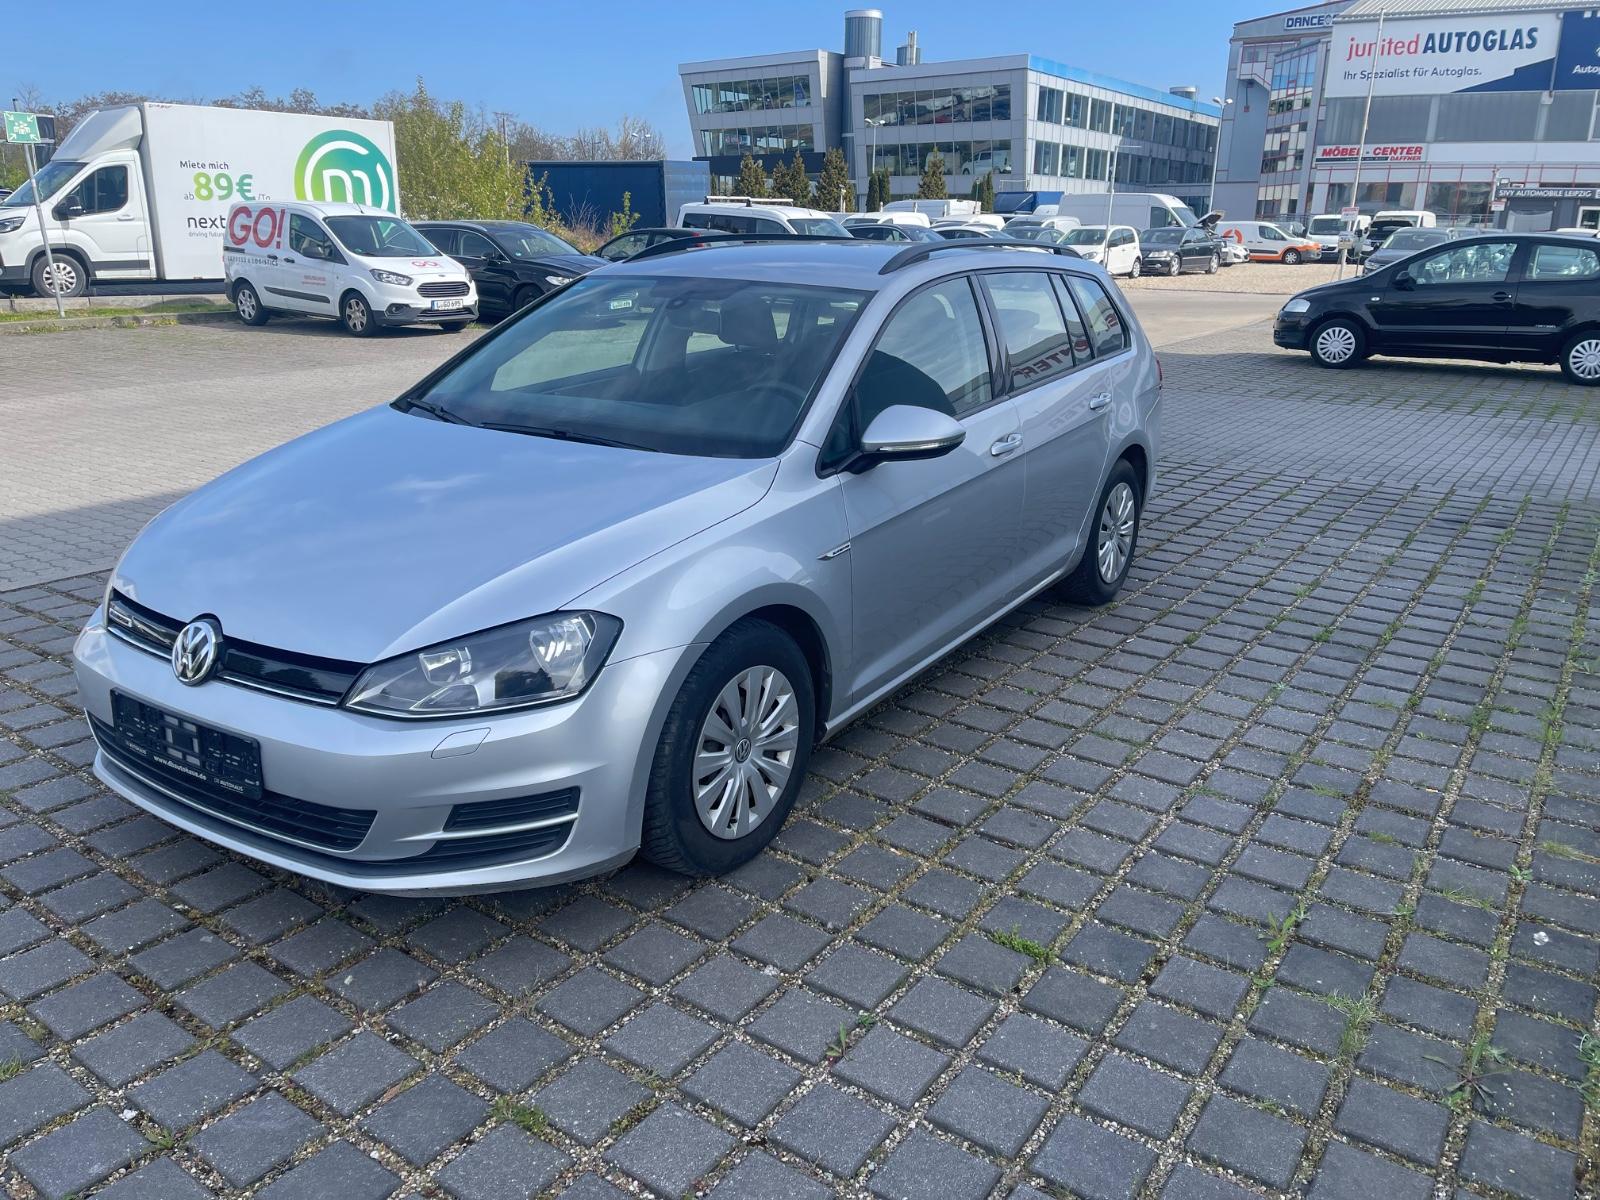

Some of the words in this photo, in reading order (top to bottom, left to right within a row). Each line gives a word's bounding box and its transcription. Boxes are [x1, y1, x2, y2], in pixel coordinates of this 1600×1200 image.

[1286, 15, 1324, 28] DANCE
[1423, 27, 1538, 54] AUTOGLAS
[1344, 70, 1357, 80] Ihr
[1360, 68, 1410, 81] Spezialist
[1413, 67, 1428, 77] für
[1431, 66, 1482, 77] Autoglas.
[1373, 146, 1423, 156] CENTER
[180, 160, 206, 169] Miete
[208, 161, 229, 170] mich
[183, 191, 195, 200] ab
[229, 206, 286, 249] GO!
